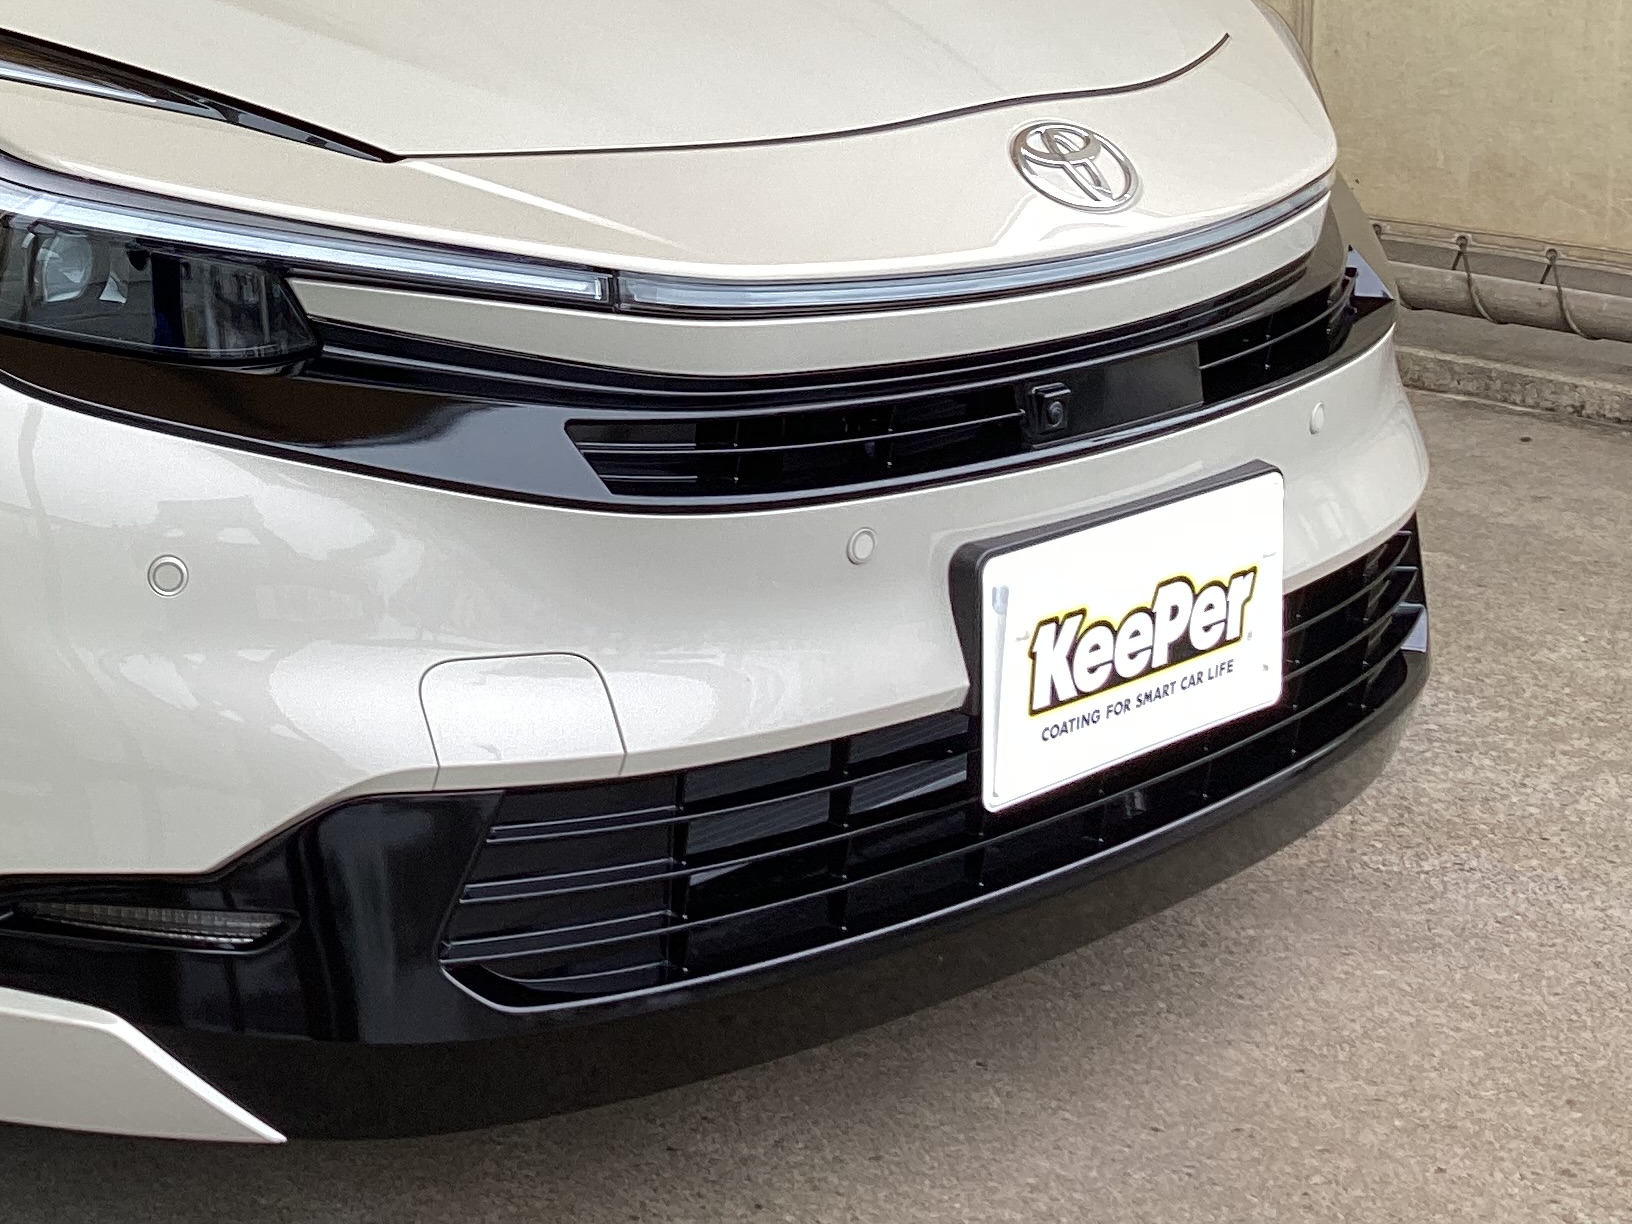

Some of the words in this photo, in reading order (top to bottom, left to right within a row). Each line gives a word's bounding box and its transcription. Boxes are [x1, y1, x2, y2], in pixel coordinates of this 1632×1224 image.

[1028, 566, 1257, 716] KeePer
[1041, 710, 1101, 742] COATING
[1106, 699, 1131, 720] FOR
[1136, 681, 1176, 709] SMART
[1180, 670, 1204, 691] CAR
[1208, 659, 1234, 681] LIFE
